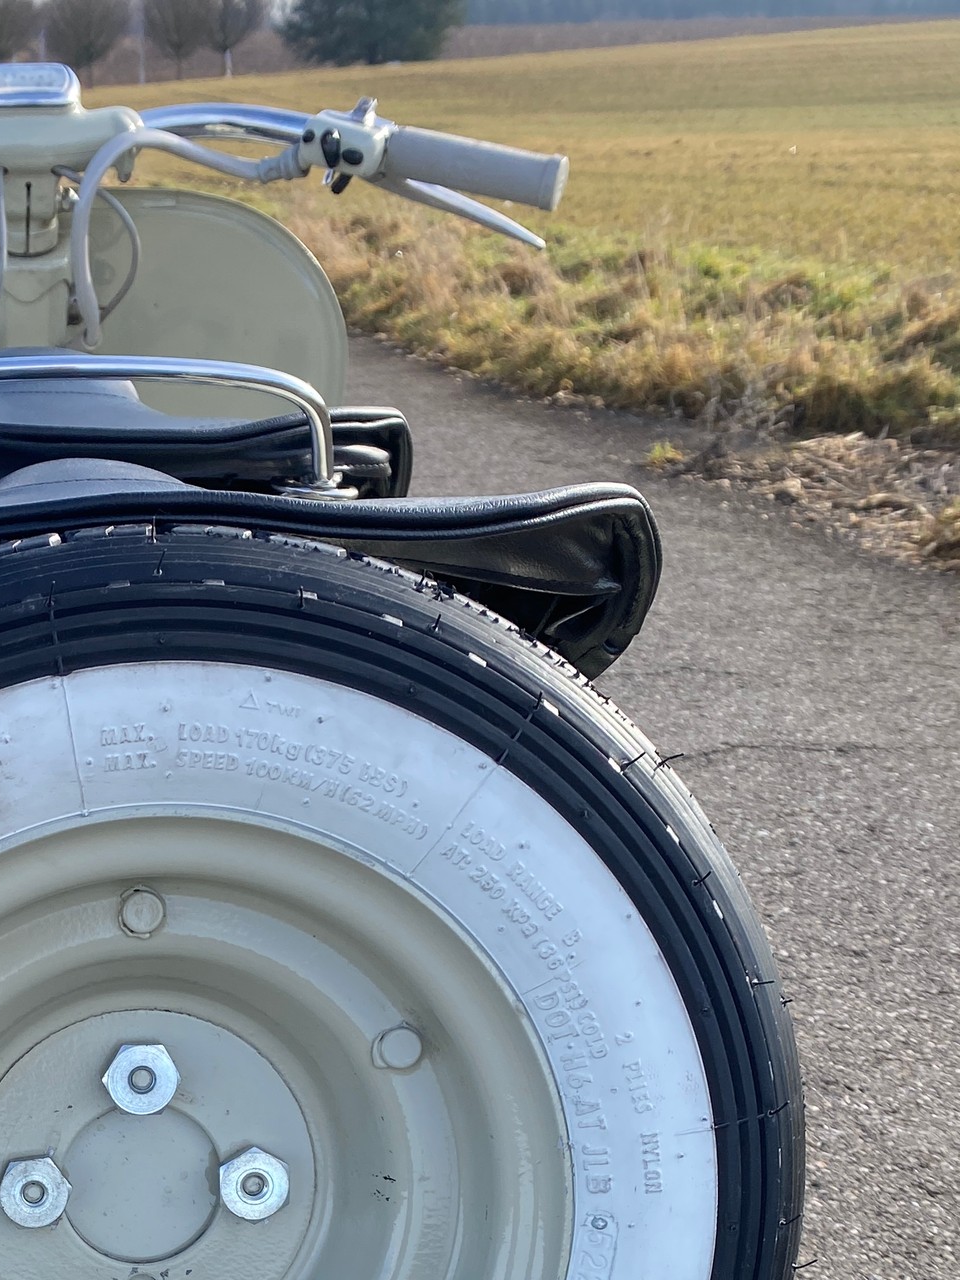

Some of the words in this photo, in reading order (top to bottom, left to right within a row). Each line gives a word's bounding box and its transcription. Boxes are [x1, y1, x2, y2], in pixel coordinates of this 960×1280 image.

[178, 722, 230, 743] LOAD
[266, 700, 302, 721] TWI
[103, 750, 158, 772] MAX.
[176, 748, 239, 772] SPEED
[460, 821, 507, 861] LOAD
[506, 862, 564, 922] RANGE
[441, 845, 472, 871] AT:
[468, 860, 507, 900] 250
[577, 1007, 610, 1061] COLD
[614, 1030, 634, 1048] 2
[533, 990, 581, 1044] DOT
[581, 1142, 614, 1195] JLB
[621, 1060, 655, 1116] PLIES
[640, 1131, 663, 1195] NYLON
